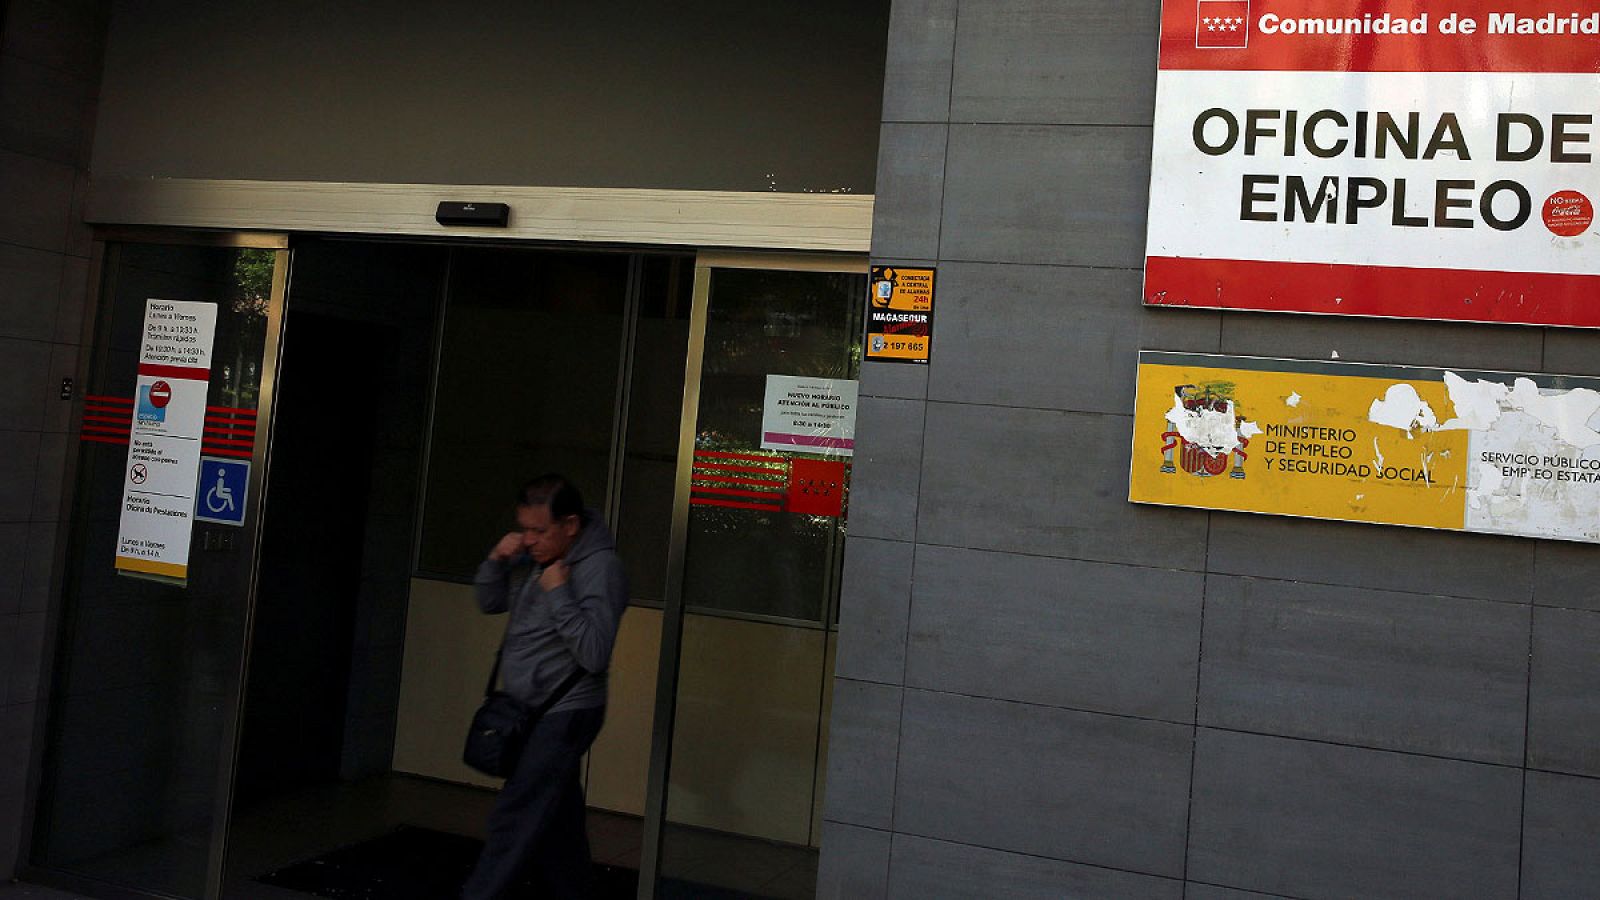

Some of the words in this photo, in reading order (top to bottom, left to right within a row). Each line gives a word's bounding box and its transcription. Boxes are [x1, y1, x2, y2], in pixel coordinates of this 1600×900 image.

[1258, 13, 1428, 35] Comunidad
[1438, 14, 1477, 34] de
[1487, 13, 1600, 35] Madrid
[1192, 107, 1472, 161] OFICINA
[1495, 112, 1593, 164] DE
[1240, 174, 1532, 231] EMPLEO
[890, 342, 905, 350] 197
[1266, 424, 1356, 442] MINISTERIO
[1265, 441, 1286, 454] DE
[1292, 443, 1352, 459] EMPLEO
[1264, 457, 1274, 470] Y
[1279, 458, 1371, 477] SEGURIDAD
[1376, 466, 1436, 483] SOCIAL
[1481, 451, 1539, 465] SERVICIO
[1543, 454, 1600, 470] PÚBLICO
